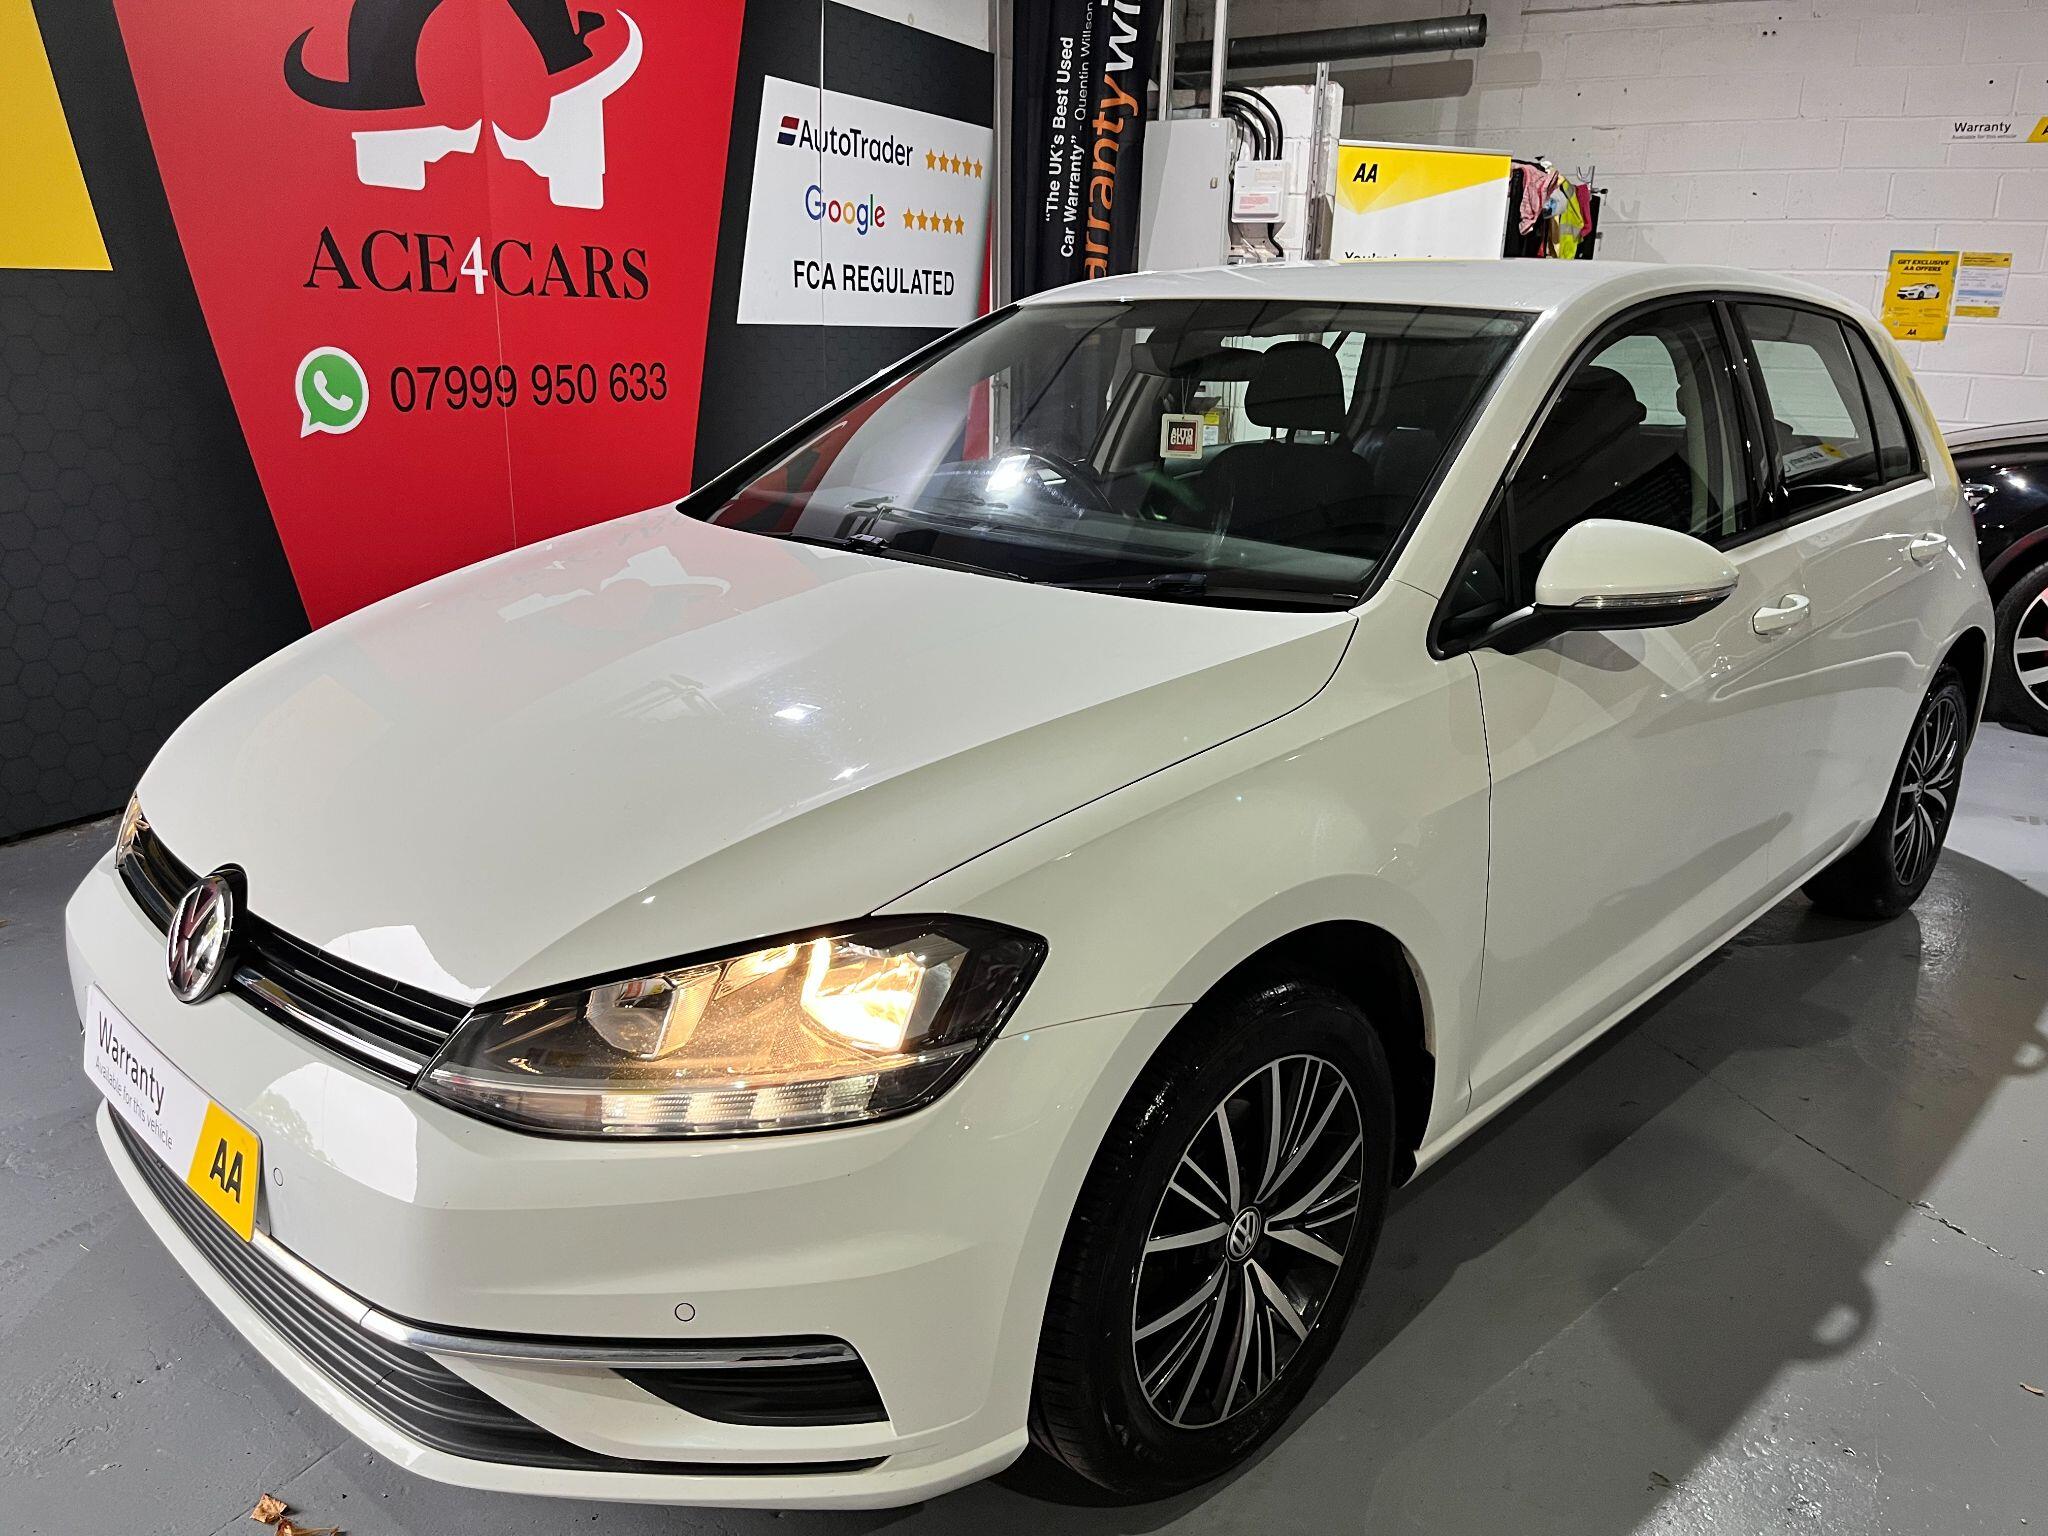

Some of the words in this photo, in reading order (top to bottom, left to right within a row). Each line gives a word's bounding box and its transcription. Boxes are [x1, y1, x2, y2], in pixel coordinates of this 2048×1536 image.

[1080, 2, 1093, 57] Willson
[1056, 37, 1074, 83] Used
[1052, 88, 1069, 129] Best
[1074, 61, 1090, 120] Quentin
[799, 119, 913, 167] AutoTrader
[1954, 121, 2012, 133] Warranty
[1048, 134, 1065, 175] UK’s
[1352, 163, 1378, 183] AA
[805, 184, 886, 235] Google
[1045, 180, 1060, 221] “The
[303, 225, 649, 300] ACE4CARS
[1060, 227, 1075, 257] Car
[793, 259, 837, 292] FCA
[842, 264, 955, 296] REGULATED
[390, 363, 517, 412] 07999
[531, 363, 597, 407] 950
[609, 362, 668, 403] 633
[98, 1011, 165, 1116] Warranty
[95, 1056, 123, 1097] Available
[122, 1085, 134, 1107] for
[133, 1100, 147, 1124] this
[146, 1114, 174, 1151] vehicle
[209, 1137, 244, 1204] AA
